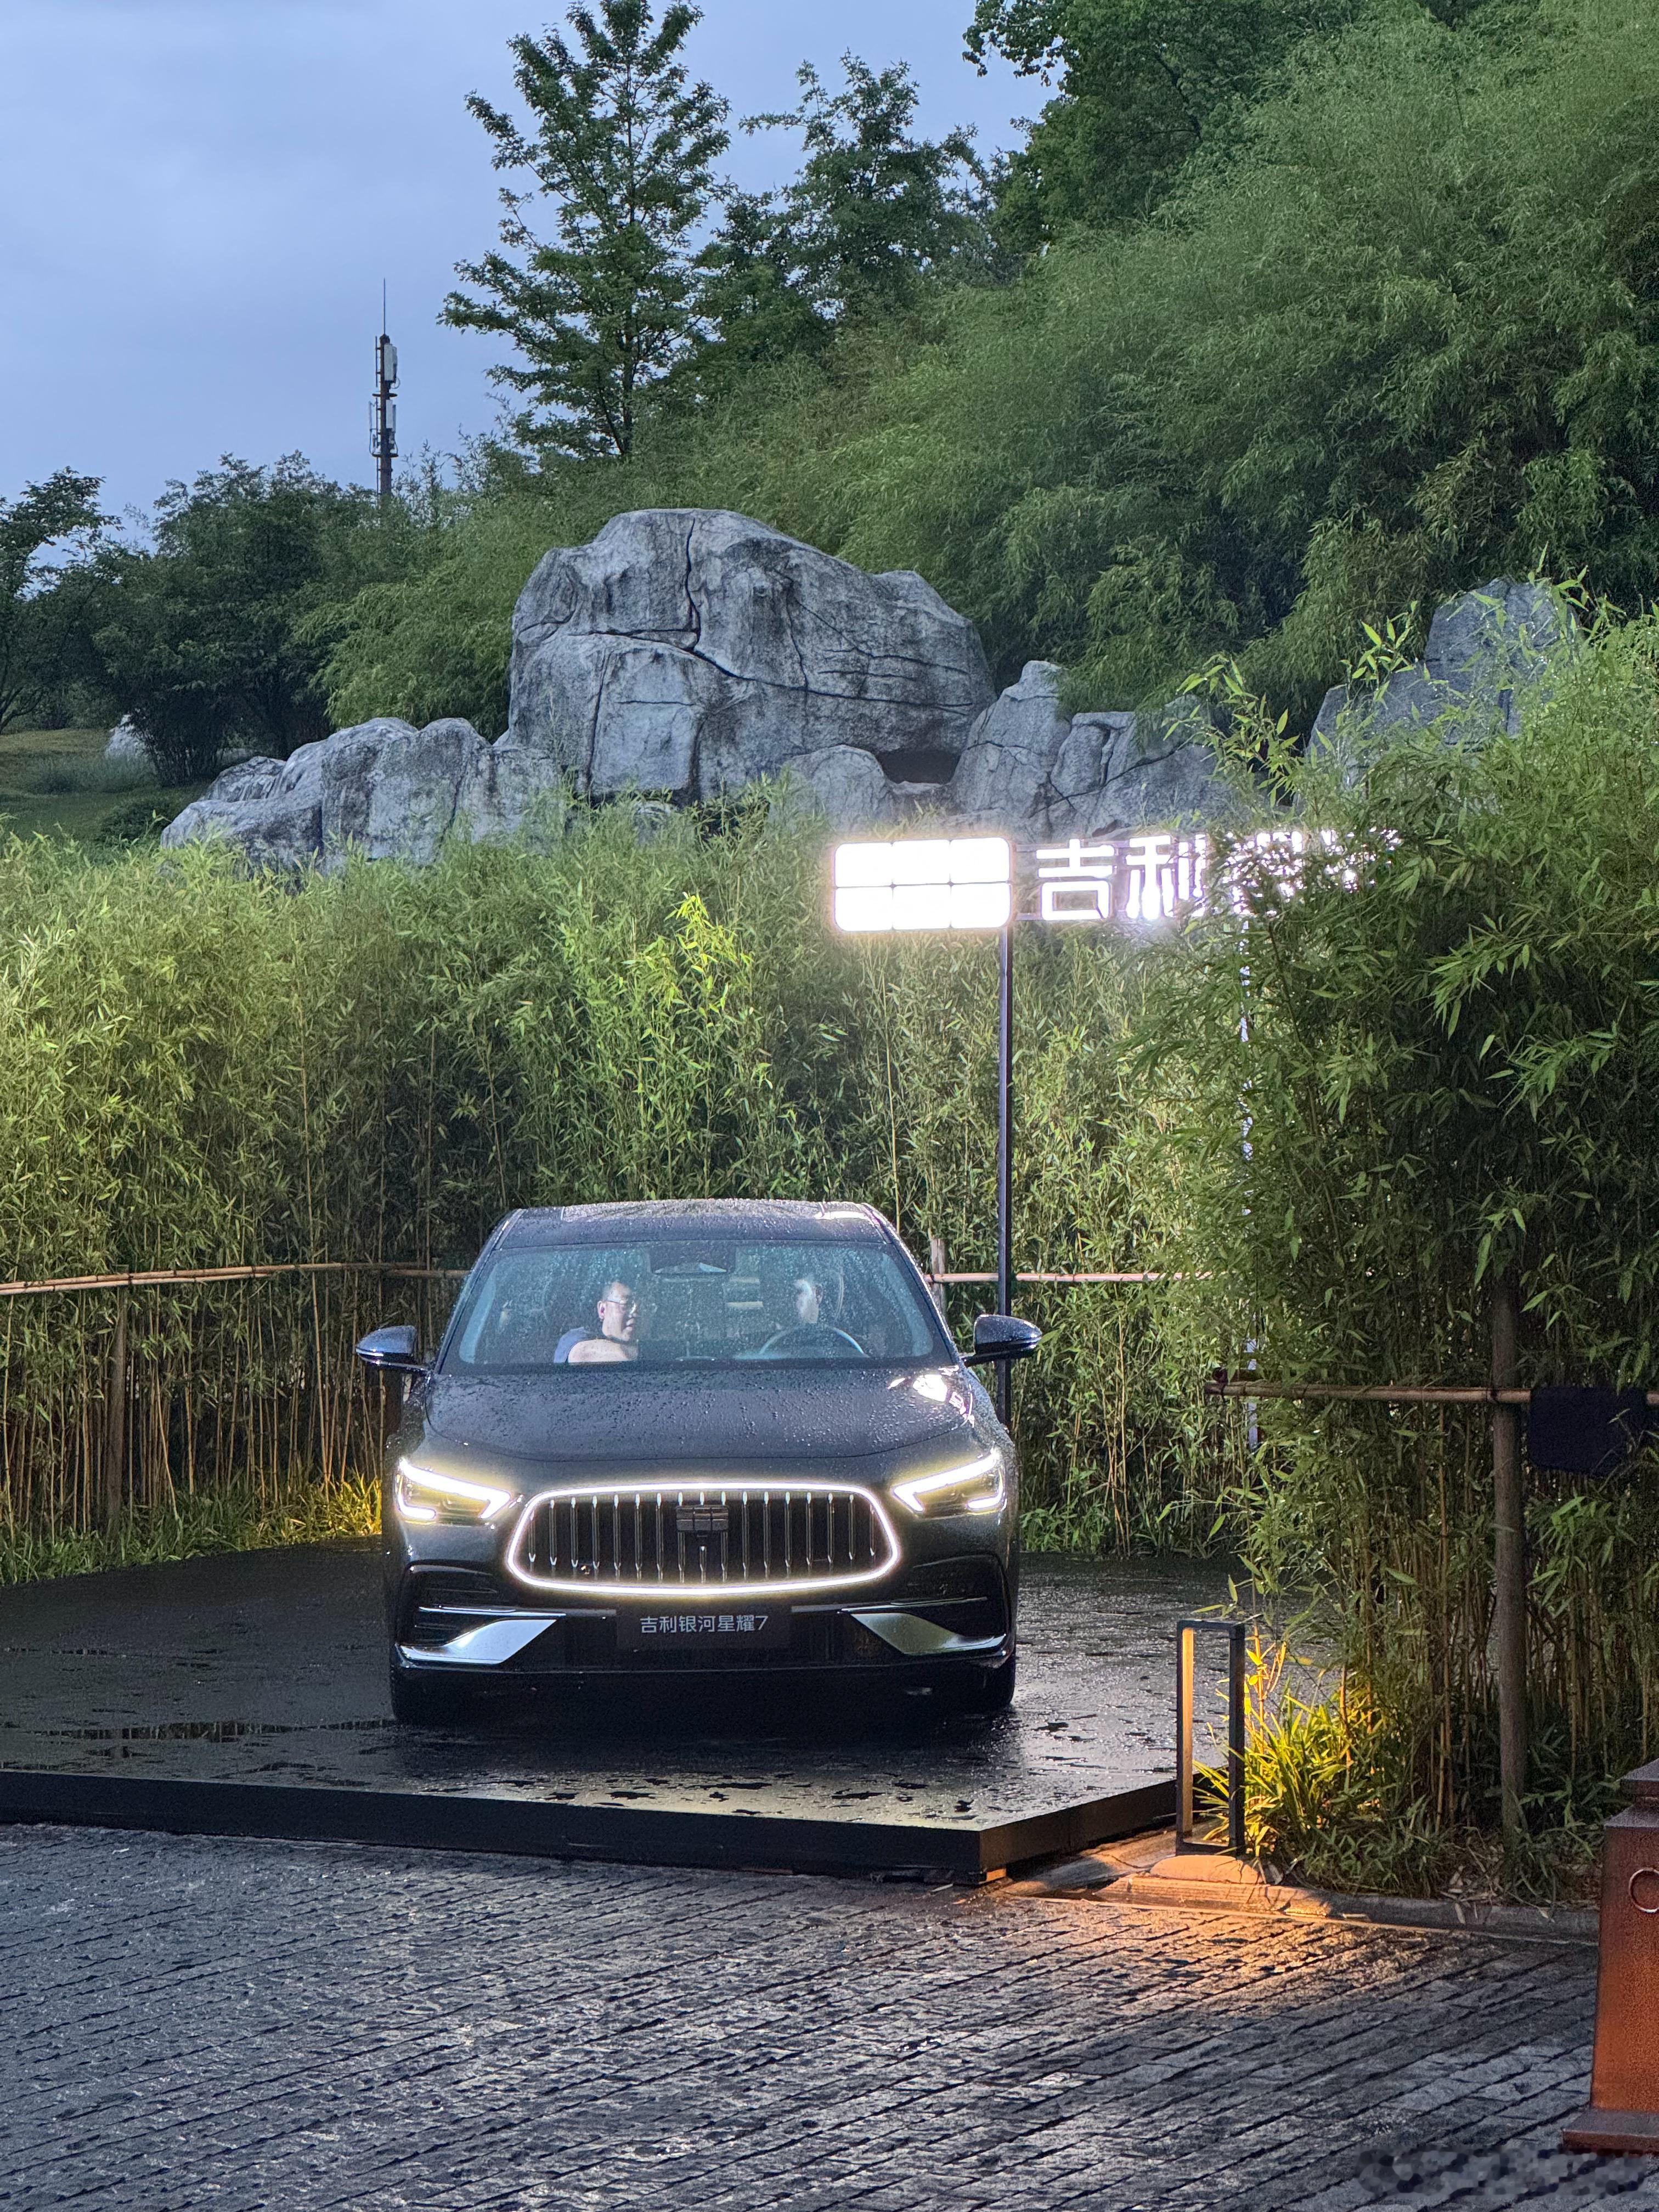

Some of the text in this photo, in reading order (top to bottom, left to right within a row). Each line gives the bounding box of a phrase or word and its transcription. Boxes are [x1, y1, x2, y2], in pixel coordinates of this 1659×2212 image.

[640, 1615, 768, 1633] 吉利银河星耀7
